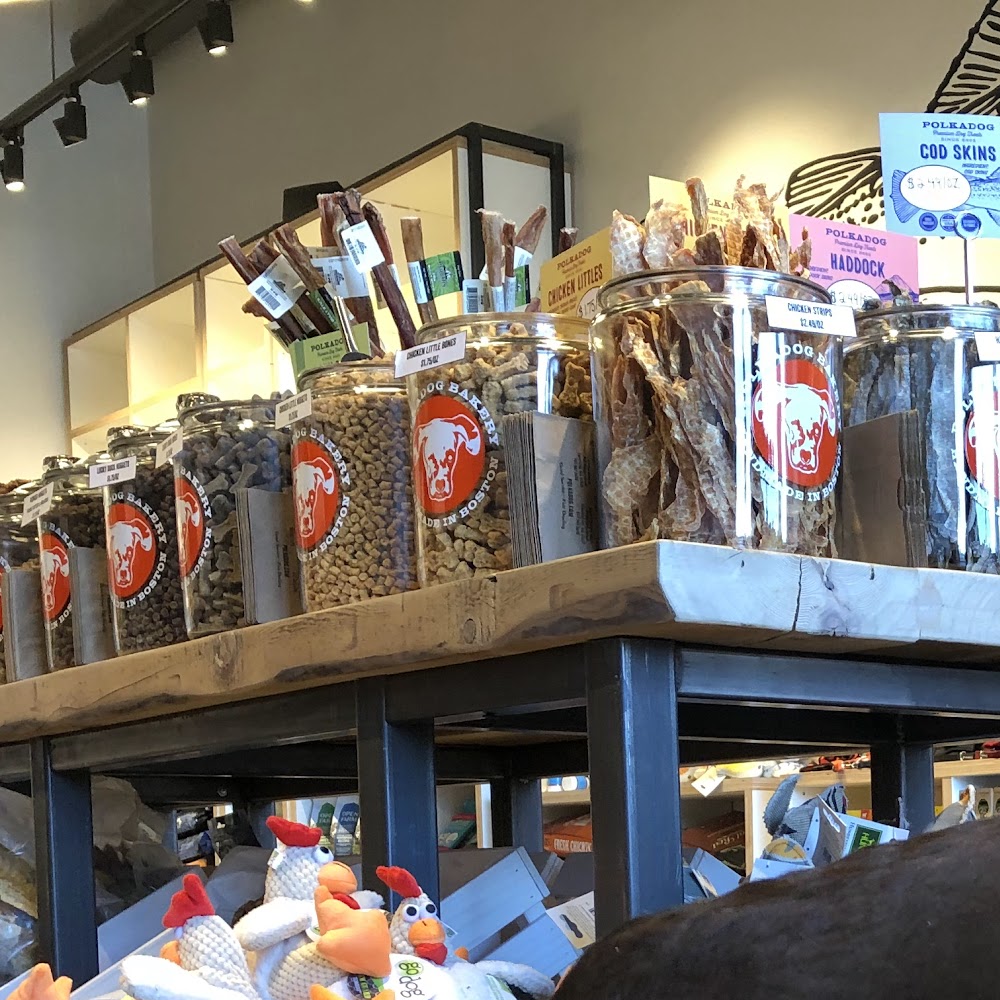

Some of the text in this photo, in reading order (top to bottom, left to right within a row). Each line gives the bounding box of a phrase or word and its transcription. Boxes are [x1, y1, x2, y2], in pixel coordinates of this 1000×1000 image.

[922, 121, 995, 131] POLKADOG
[920, 144, 996, 162] COD SKINS
[826, 228, 887, 246] POLKADOG
[830, 252, 885, 278] HADDOCK
[548, 279, 576, 307] CHICKEN
[578, 264, 603, 290] LITTLES
[788, 302, 833, 318] CHICKEN STRIPS
[311, 338, 344, 352] POLKADO
[406, 338, 456, 360] CHICKEN LITTLE BONES
[420, 380, 500, 448] DOG BAKERY
[309, 428, 350, 486] BAKERY
[178, 466, 213, 520] BAKERY
[442, 512, 456, 527] IN
[460, 456, 499, 518] BOSTON
[808, 491, 822, 502] IN
[126, 492, 168, 545] BAKERY
[308, 494, 350, 561] IN BOSTON
[190, 526, 212, 585] BOSTON
[126, 551, 167, 608] IN BOSTON
[554, 838, 570, 850] FRESH
[398, 976, 425, 998] dog
